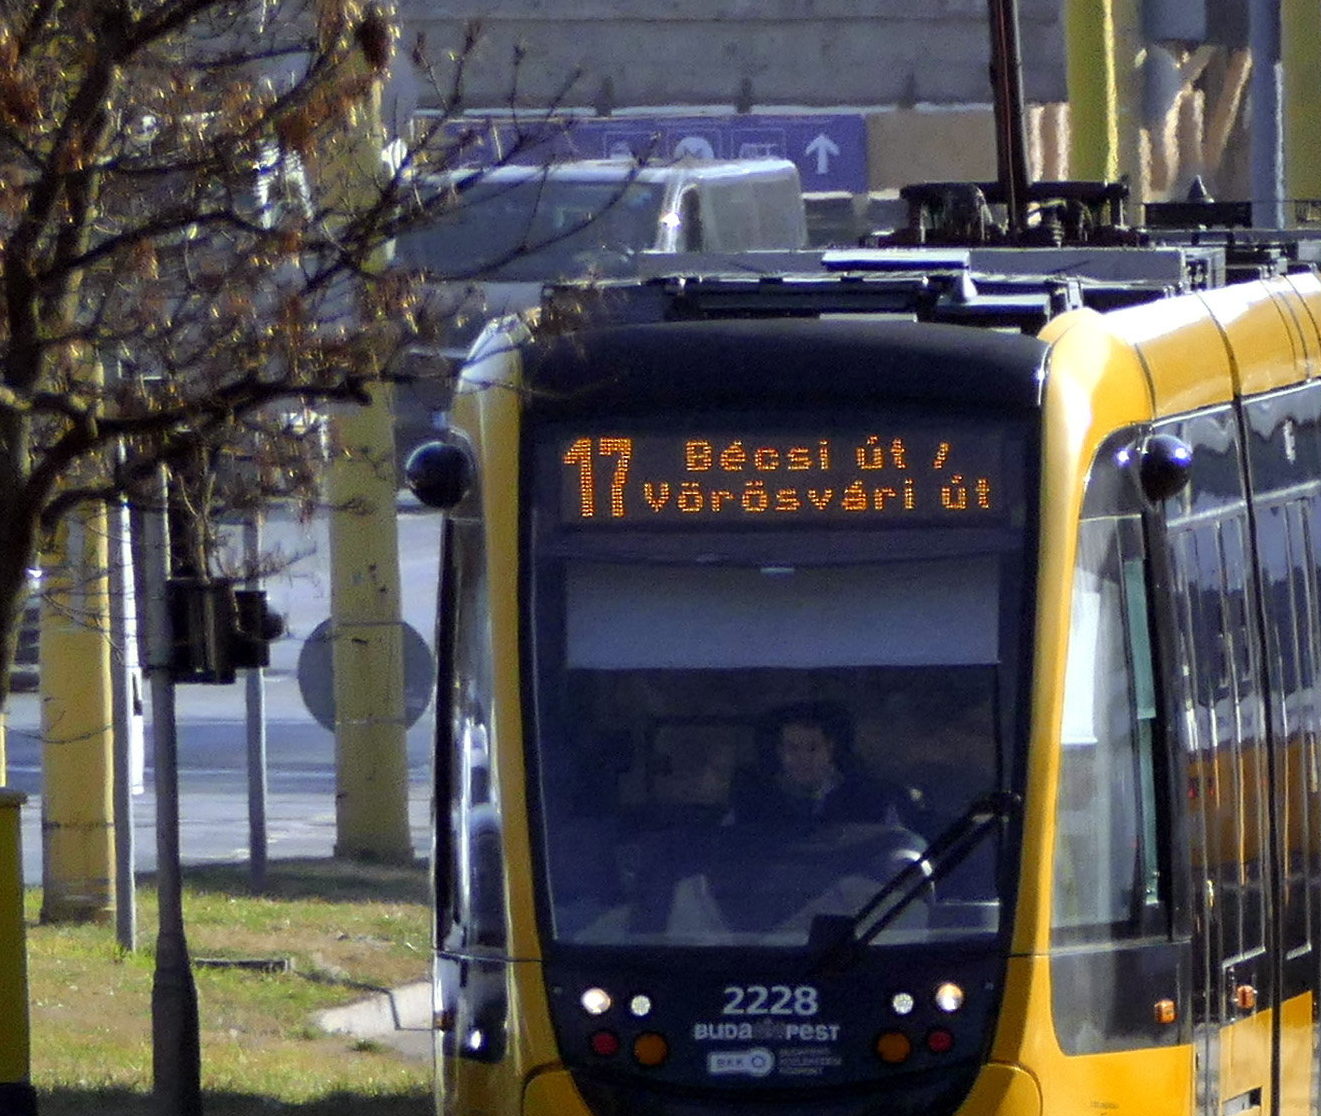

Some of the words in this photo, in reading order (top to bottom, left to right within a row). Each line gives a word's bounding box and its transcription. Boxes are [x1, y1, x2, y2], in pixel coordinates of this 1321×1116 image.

[684, 438, 831, 472] Bécsi
[855, 434, 907, 471] út
[931, 440, 952, 471] /
[562, 436, 633, 518] 17
[940, 474, 991, 511] út
[722, 985, 819, 1016] 2228
